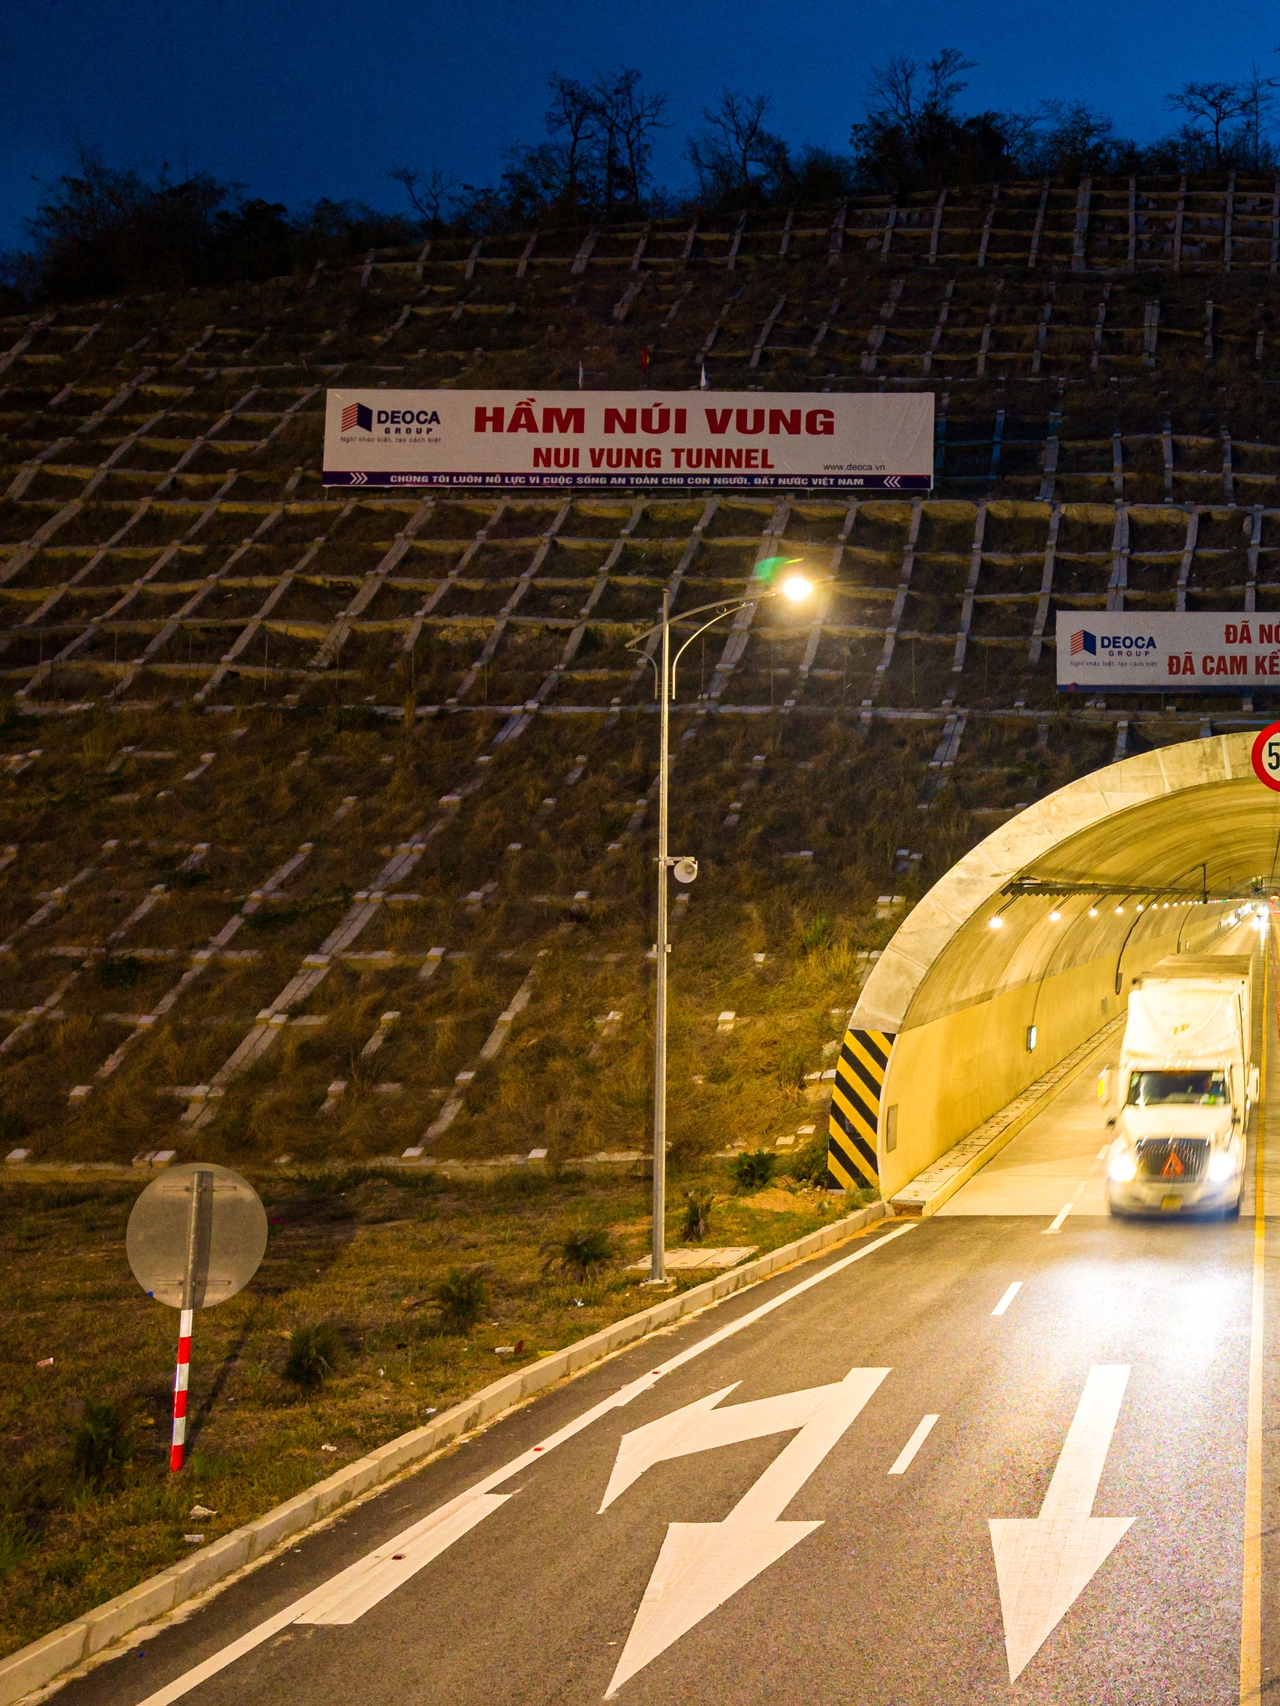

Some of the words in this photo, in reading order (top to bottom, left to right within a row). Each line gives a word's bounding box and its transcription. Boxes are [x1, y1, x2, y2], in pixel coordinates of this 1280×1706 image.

[377, 410, 441, 425] DEOCA
[474, 397, 585, 434] HẦM
[604, 402, 687, 435] NÚI
[705, 408, 835, 435] VUNG
[384, 427, 433, 435] GROUP
[533, 447, 580, 468] NUI
[589, 448, 662, 469] VUNG
[671, 448, 775, 469] TUNNEL
[823, 463, 885, 472] www.deoca.vn
[390, 474, 429, 483] CHÚNG
[432, 474, 450, 483] TÔI
[453, 474, 482, 484] LUÔN
[505, 475, 526, 485] LỰC
[529, 475, 540, 484] VÌ
[543, 476, 573, 485] CUỘC
[576, 474, 607, 485] SỐNG
[610, 477, 626, 485] AN
[629, 475, 659, 485] TOÀN
[661, 477, 684, 485] CHO
[687, 477, 710, 485] CON
[754, 475, 775, 485] ĐẤT
[778, 476, 809, 486] NƯỚC
[811, 476, 835, 486] VIỆT
[838, 478, 864, 486] NAM
[1224, 620, 1252, 644] ĐÃ
[1100, 636, 1157, 649] DEOCA
[1167, 651, 1196, 676] ĐÃ
[1202, 655, 1248, 676] CAM
